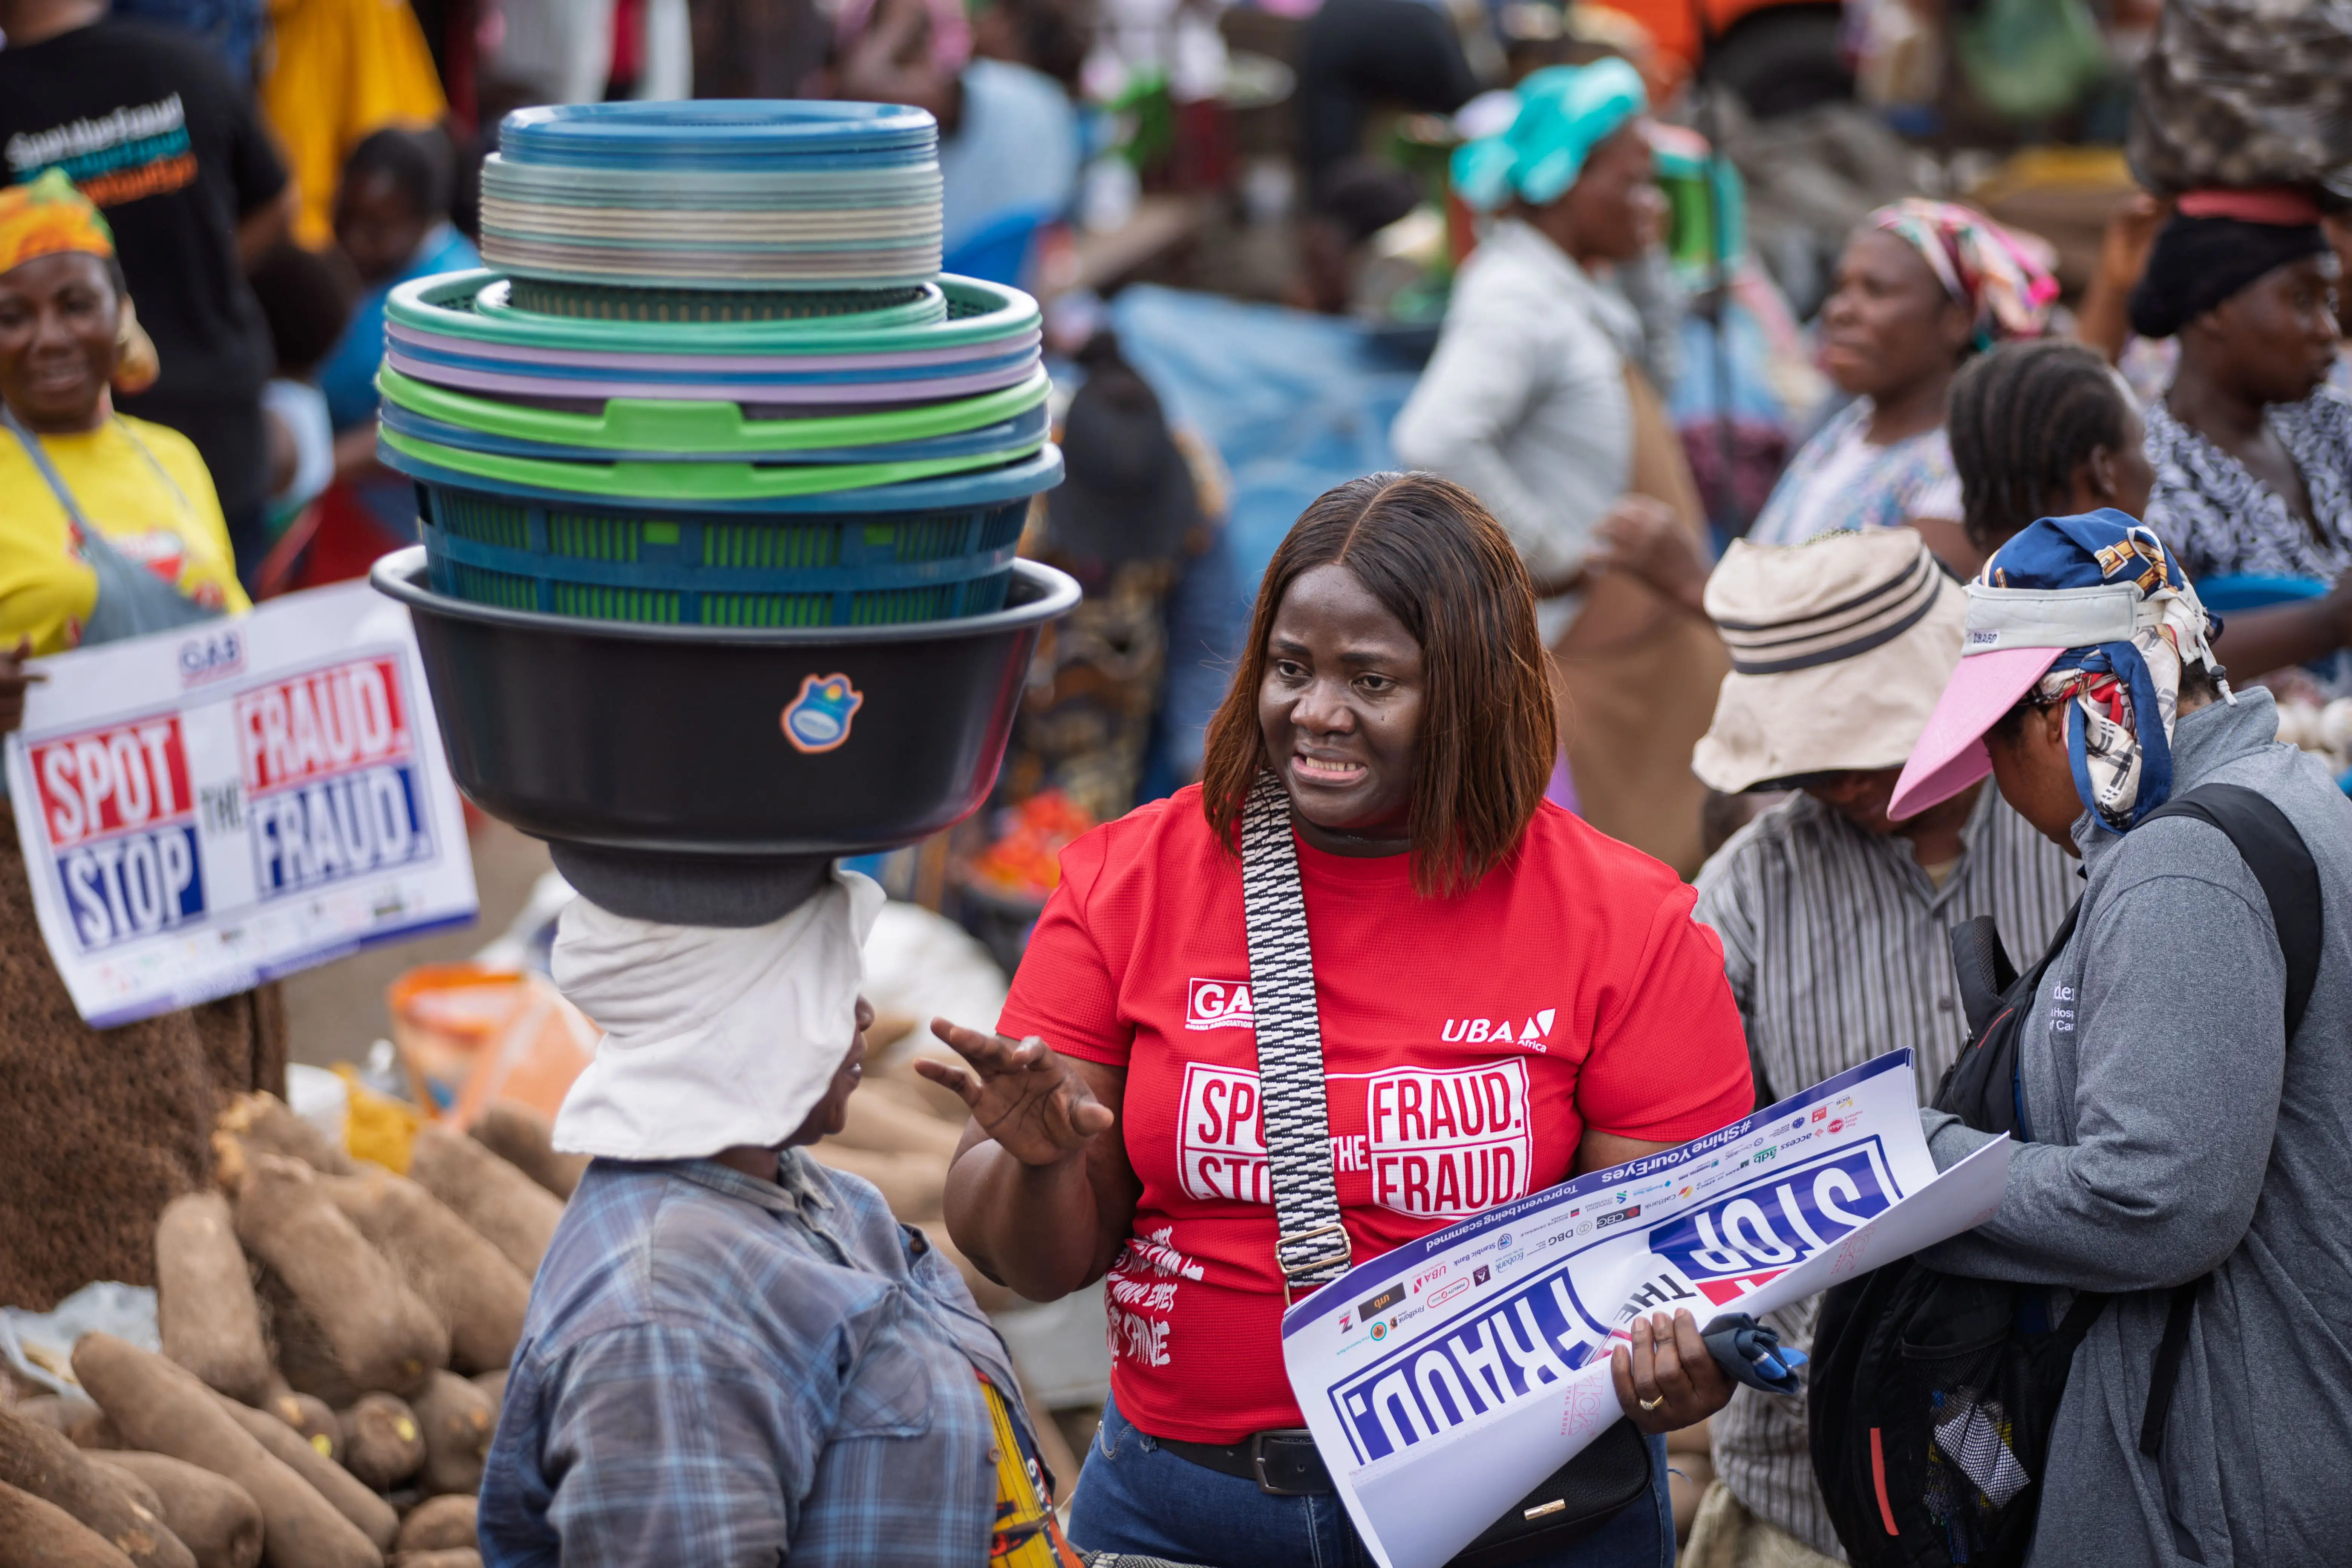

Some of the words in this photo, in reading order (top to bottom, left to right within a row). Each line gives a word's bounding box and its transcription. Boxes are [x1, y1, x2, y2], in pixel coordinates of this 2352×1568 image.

[241, 666, 411, 793] FRAUD.
[42, 722, 176, 841] SPOT
[201, 783, 244, 839] THE
[254, 764, 430, 890] FRAUD.
[67, 829, 195, 950] STOP
[1194, 983, 1253, 1018] GA
[1209, 1020, 1253, 1029] ASSOCIATION
[1442, 1018, 1513, 1042] UBA
[1517, 1039, 1547, 1053] Africa
[1199, 1079, 1268, 1146] SP
[1374, 1072, 1521, 1143] FRAUD.
[1836, 1096, 1850, 1105] GCB
[1829, 1122, 1843, 1130] absa
[1780, 1133, 1812, 1150] access
[1333, 1135, 1369, 1171] THE
[1197, 1154, 1273, 1201] STO
[1377, 1145, 1521, 1212] FRAUD.
[1517, 1187, 1562, 1213] prevent
[1585, 1197, 1613, 1209] chartered
[1586, 1200, 1613, 1212] standard
[1645, 1194, 1676, 1210] CalBank
[1484, 1209, 1516, 1225] being
[1597, 1213, 1624, 1227] CBG
[1689, 1167, 1869, 1272] STOP
[1426, 1221, 1483, 1252] scammed
[1520, 1224, 1547, 1237] GENERALE
[1548, 1229, 1574, 1246] DBG
[1471, 1242, 1496, 1258] Stanbic
[1453, 1254, 1470, 1266] Bank
[1495, 1252, 1524, 1272] Ecobank
[1424, 1265, 1446, 1283] UBA
[1448, 1282, 1465, 1294] FIDELITY
[1339, 1309, 1352, 1320] ZENITH
[1398, 1305, 1425, 1324] FirstBank
[1561, 1411, 1570, 1436] MEDIA
